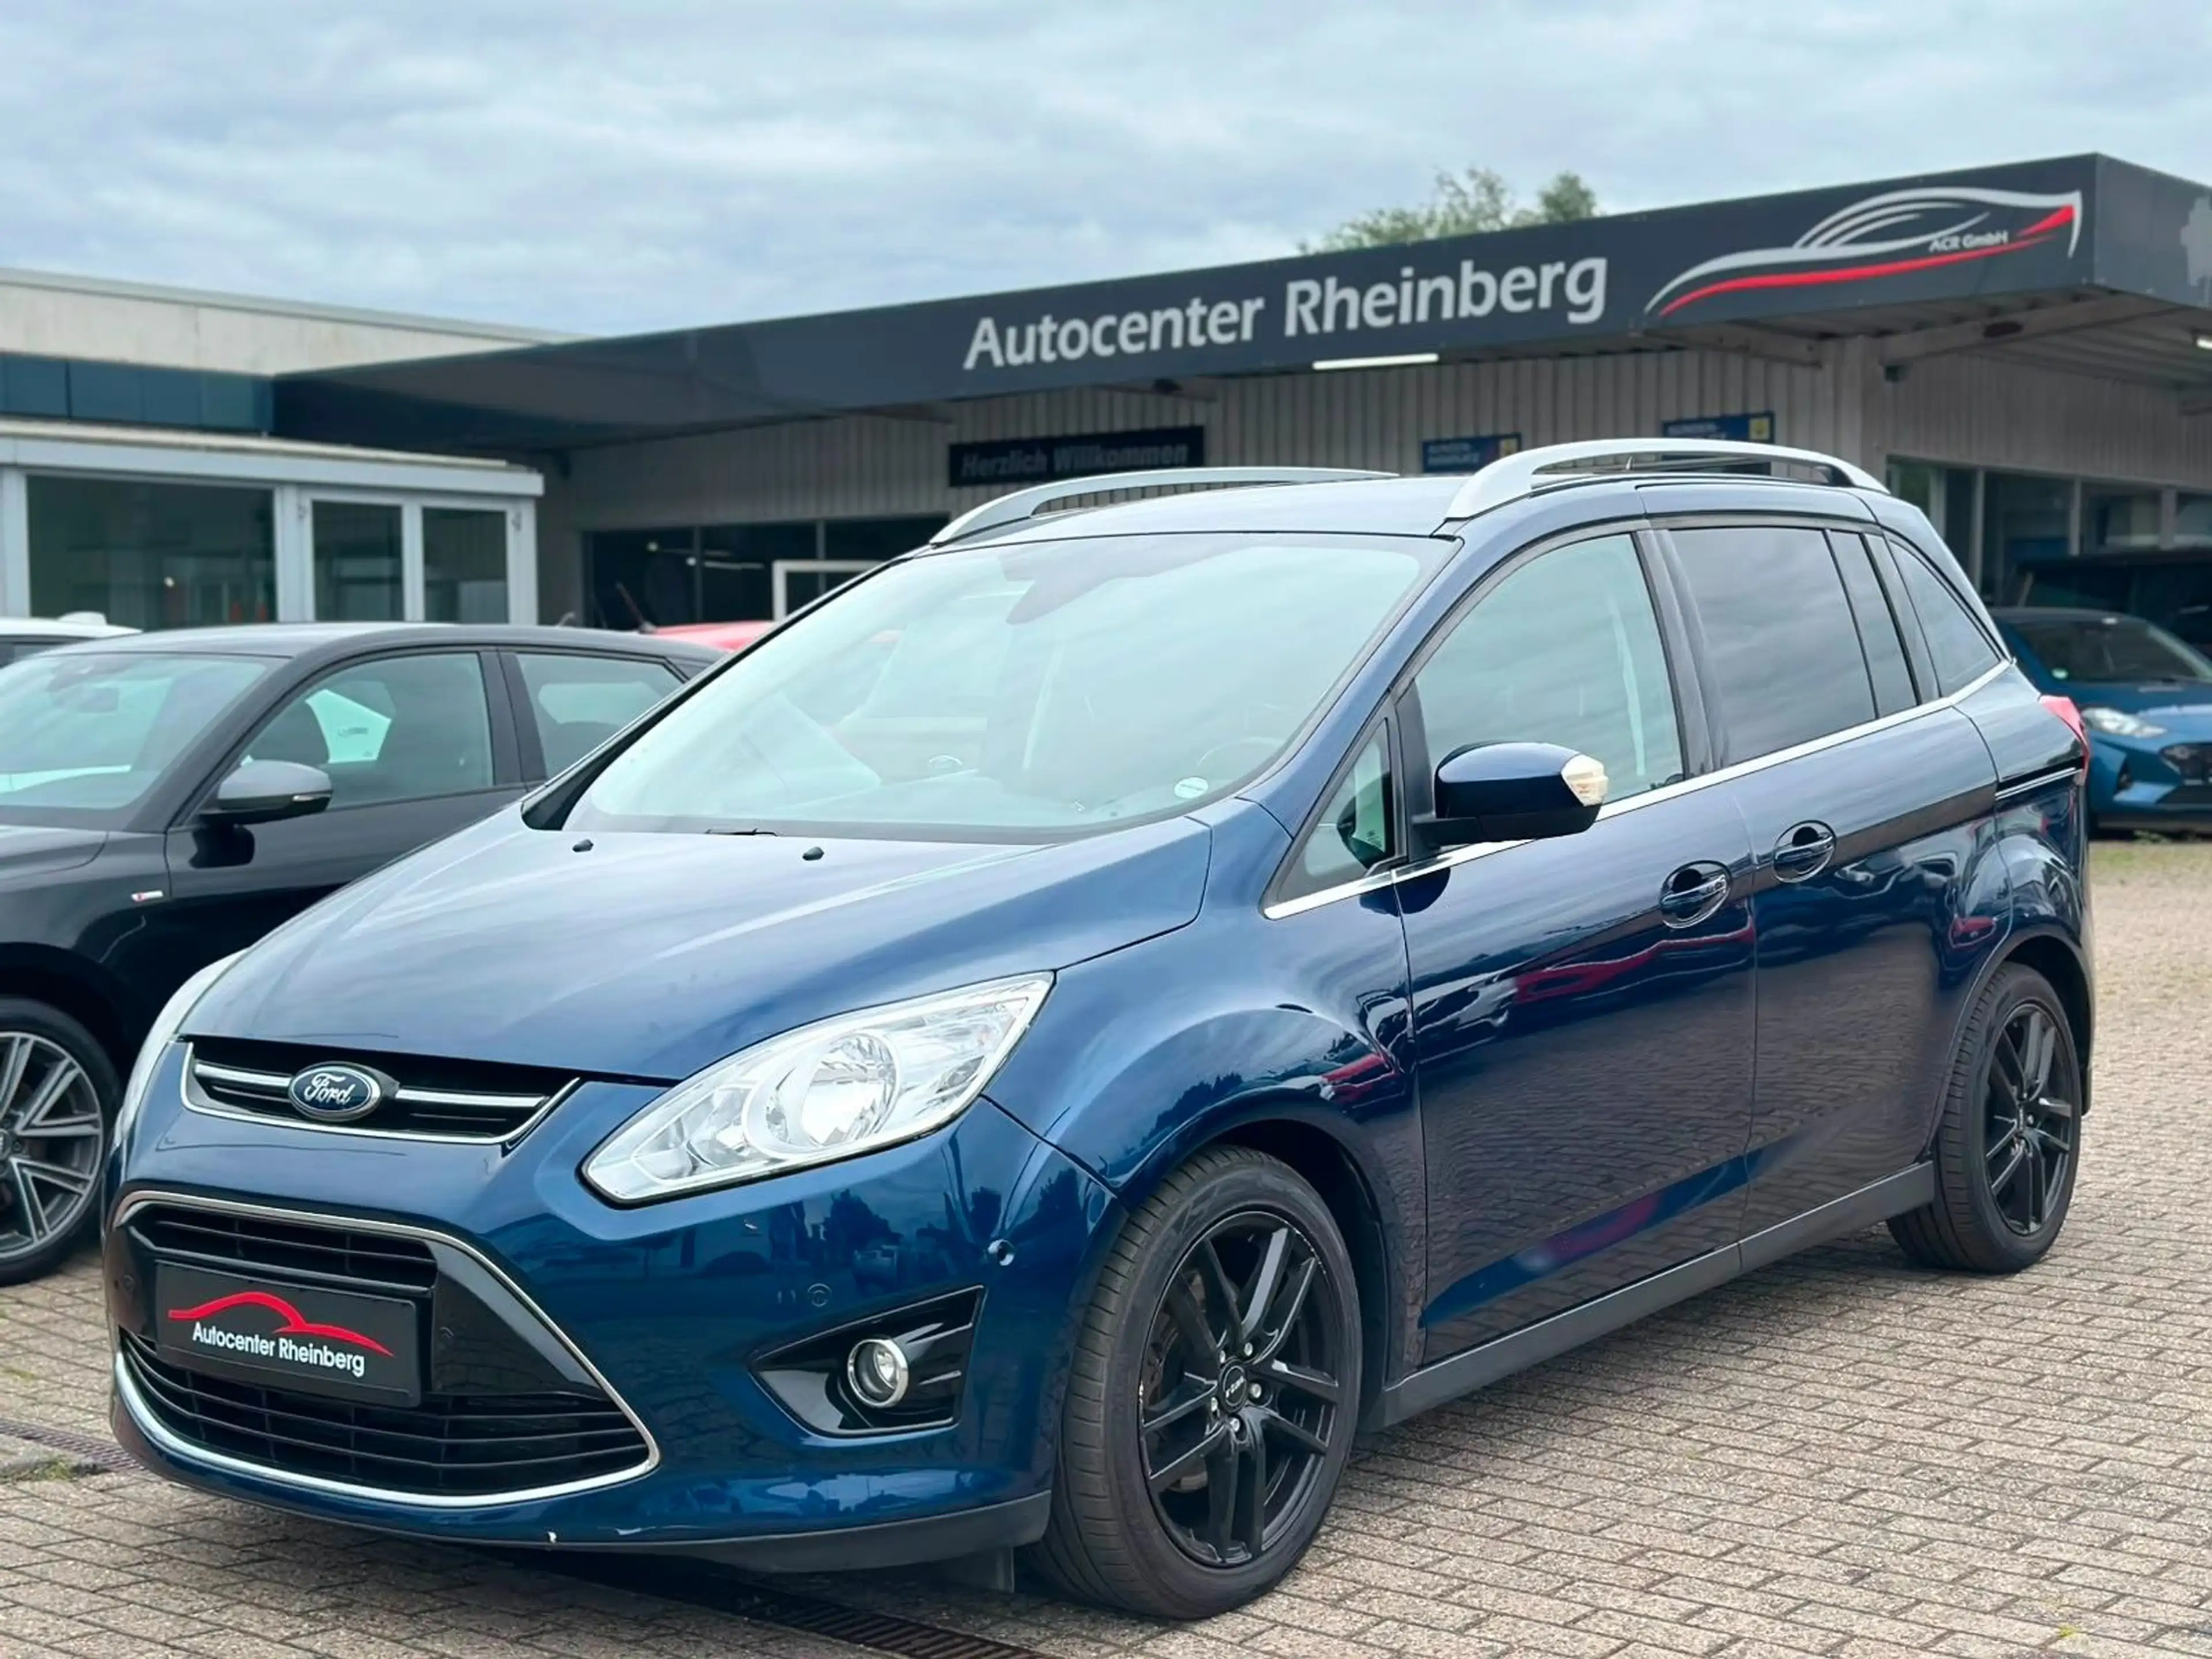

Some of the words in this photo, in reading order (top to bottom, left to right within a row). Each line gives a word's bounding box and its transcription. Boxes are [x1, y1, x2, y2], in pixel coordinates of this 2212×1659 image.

[963, 296, 1264, 370] Autocenter
[1285, 257, 1608, 338] Rheinberg
[304, 1072, 357, 1105] Ford
[192, 1321, 275, 1357] Autocenter
[279, 1338, 365, 1377] Rheinberg
